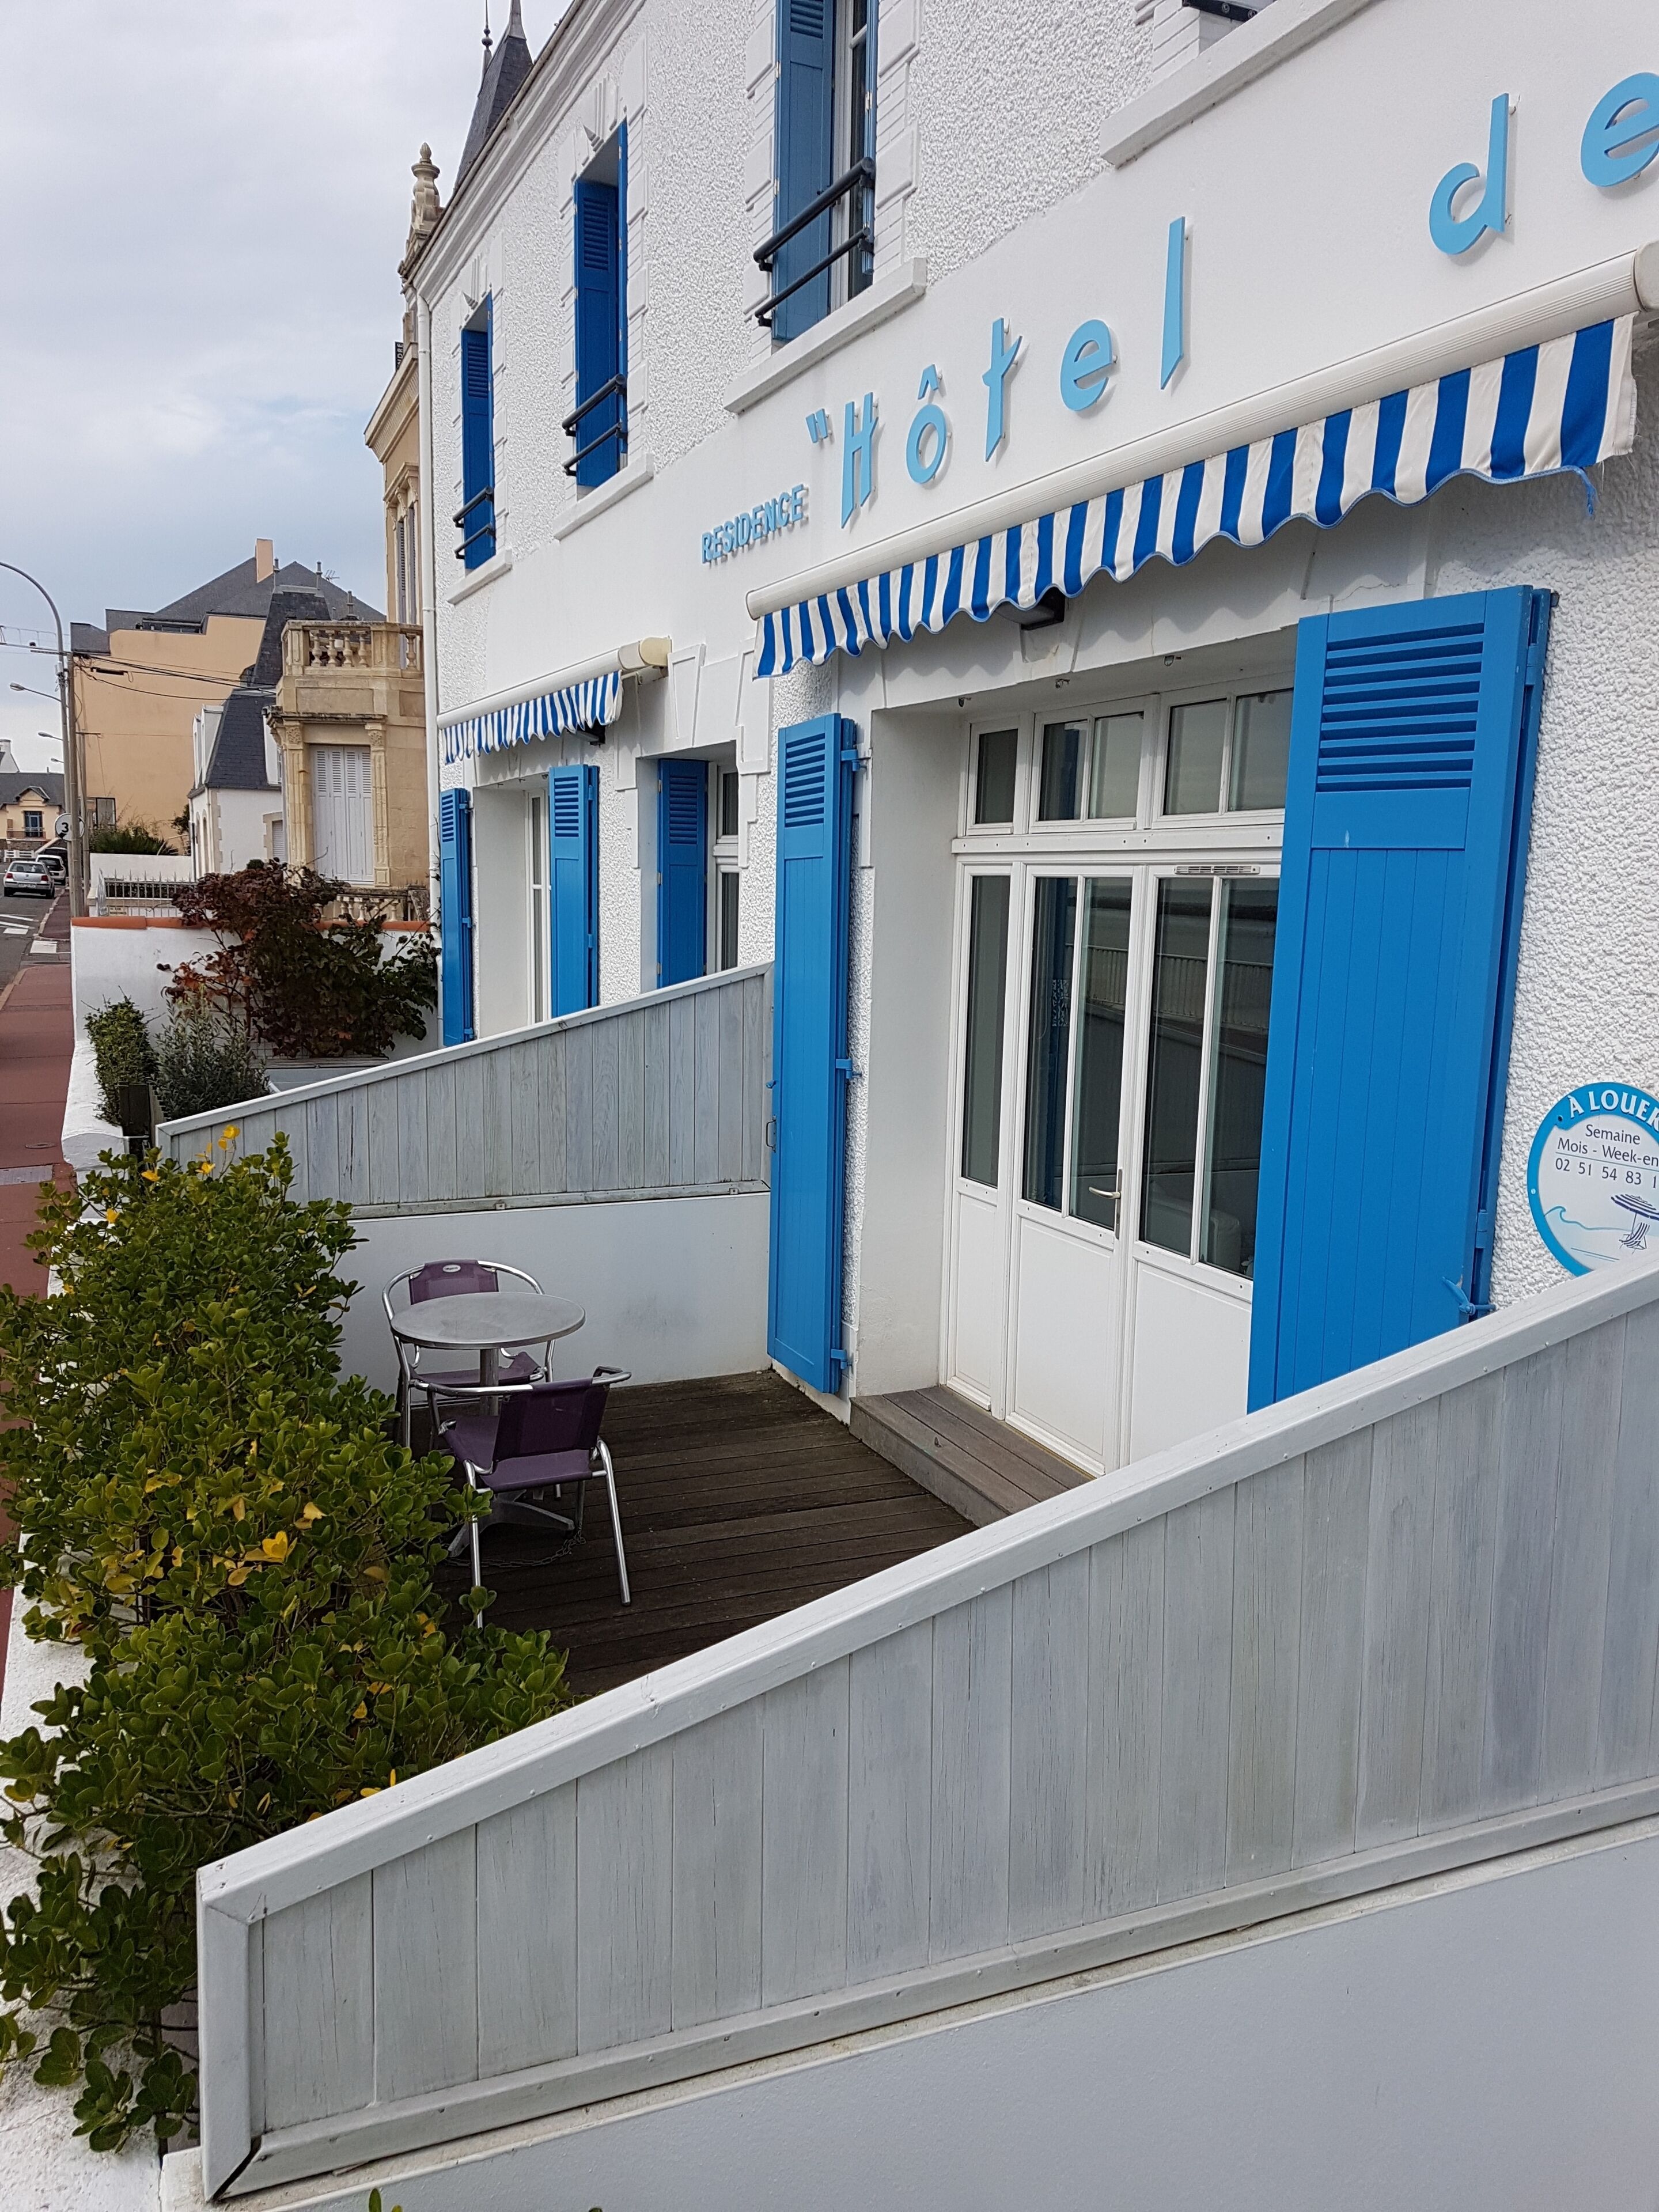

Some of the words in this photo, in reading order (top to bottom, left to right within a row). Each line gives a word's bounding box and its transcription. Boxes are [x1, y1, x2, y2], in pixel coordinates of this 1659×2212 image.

[1429, 71, 1659, 255] de
[702, 483, 804, 564] RESIDENCE
[61, 822, 72, 833] 3
[1567, 1095, 1584, 1119] À
[1585, 1124, 1641, 1145] Semaine
[1557, 1137, 1588, 1154] Mois
[1602, 1145, 1659, 1167] Week-en
[1555, 1157, 1570, 1172] 02
[1578, 1161, 1592, 1176] 51
[1601, 1166, 1618, 1181] 54
[1626, 1171, 1641, 1185] 83
